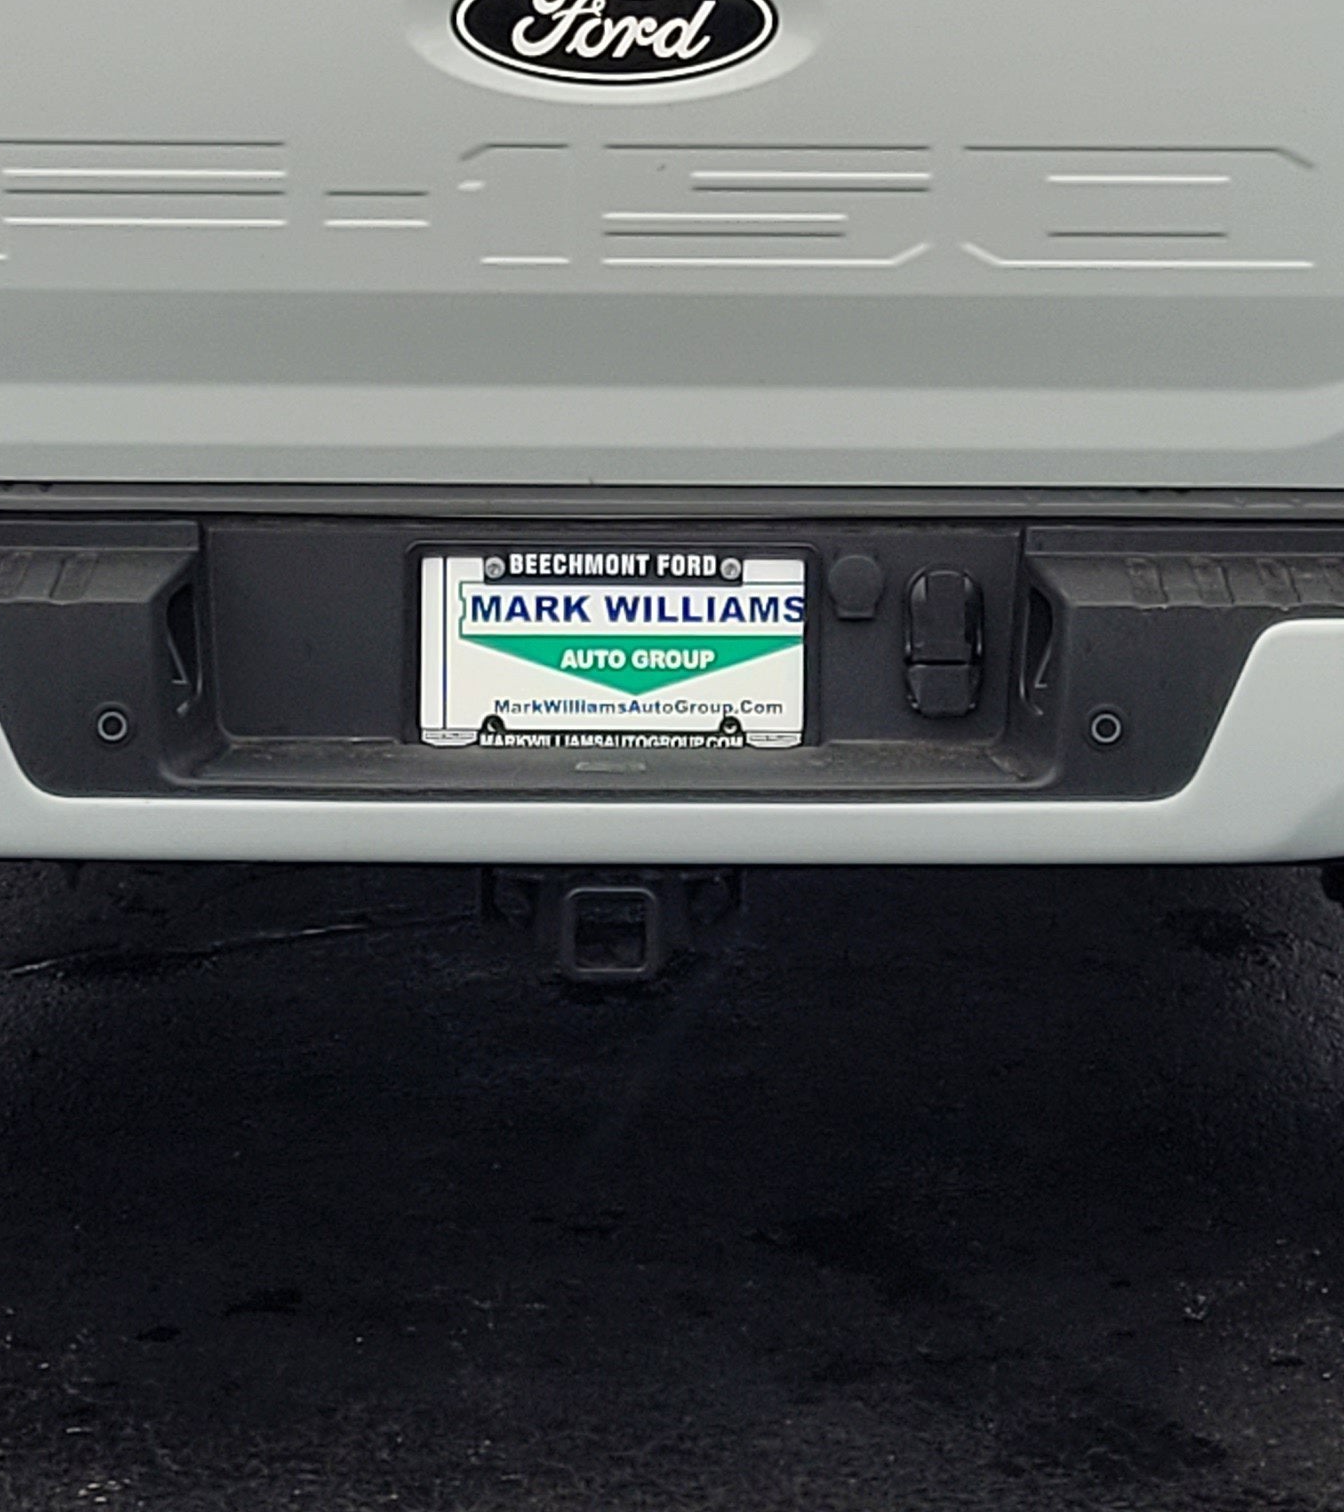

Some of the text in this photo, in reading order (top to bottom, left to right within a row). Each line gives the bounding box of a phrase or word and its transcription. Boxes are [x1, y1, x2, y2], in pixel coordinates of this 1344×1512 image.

[509, 553, 717, 577] BEECHMONT FORD
[471, 594, 804, 623] MARK WILLIAMS
[559, 648, 717, 670] AUTO GROUP
[493, 699, 784, 718] MarkWilliamsAutoGroup.Com
[479, 733, 744, 748] MARKWILLIAMSAUTOGROUPCOM
